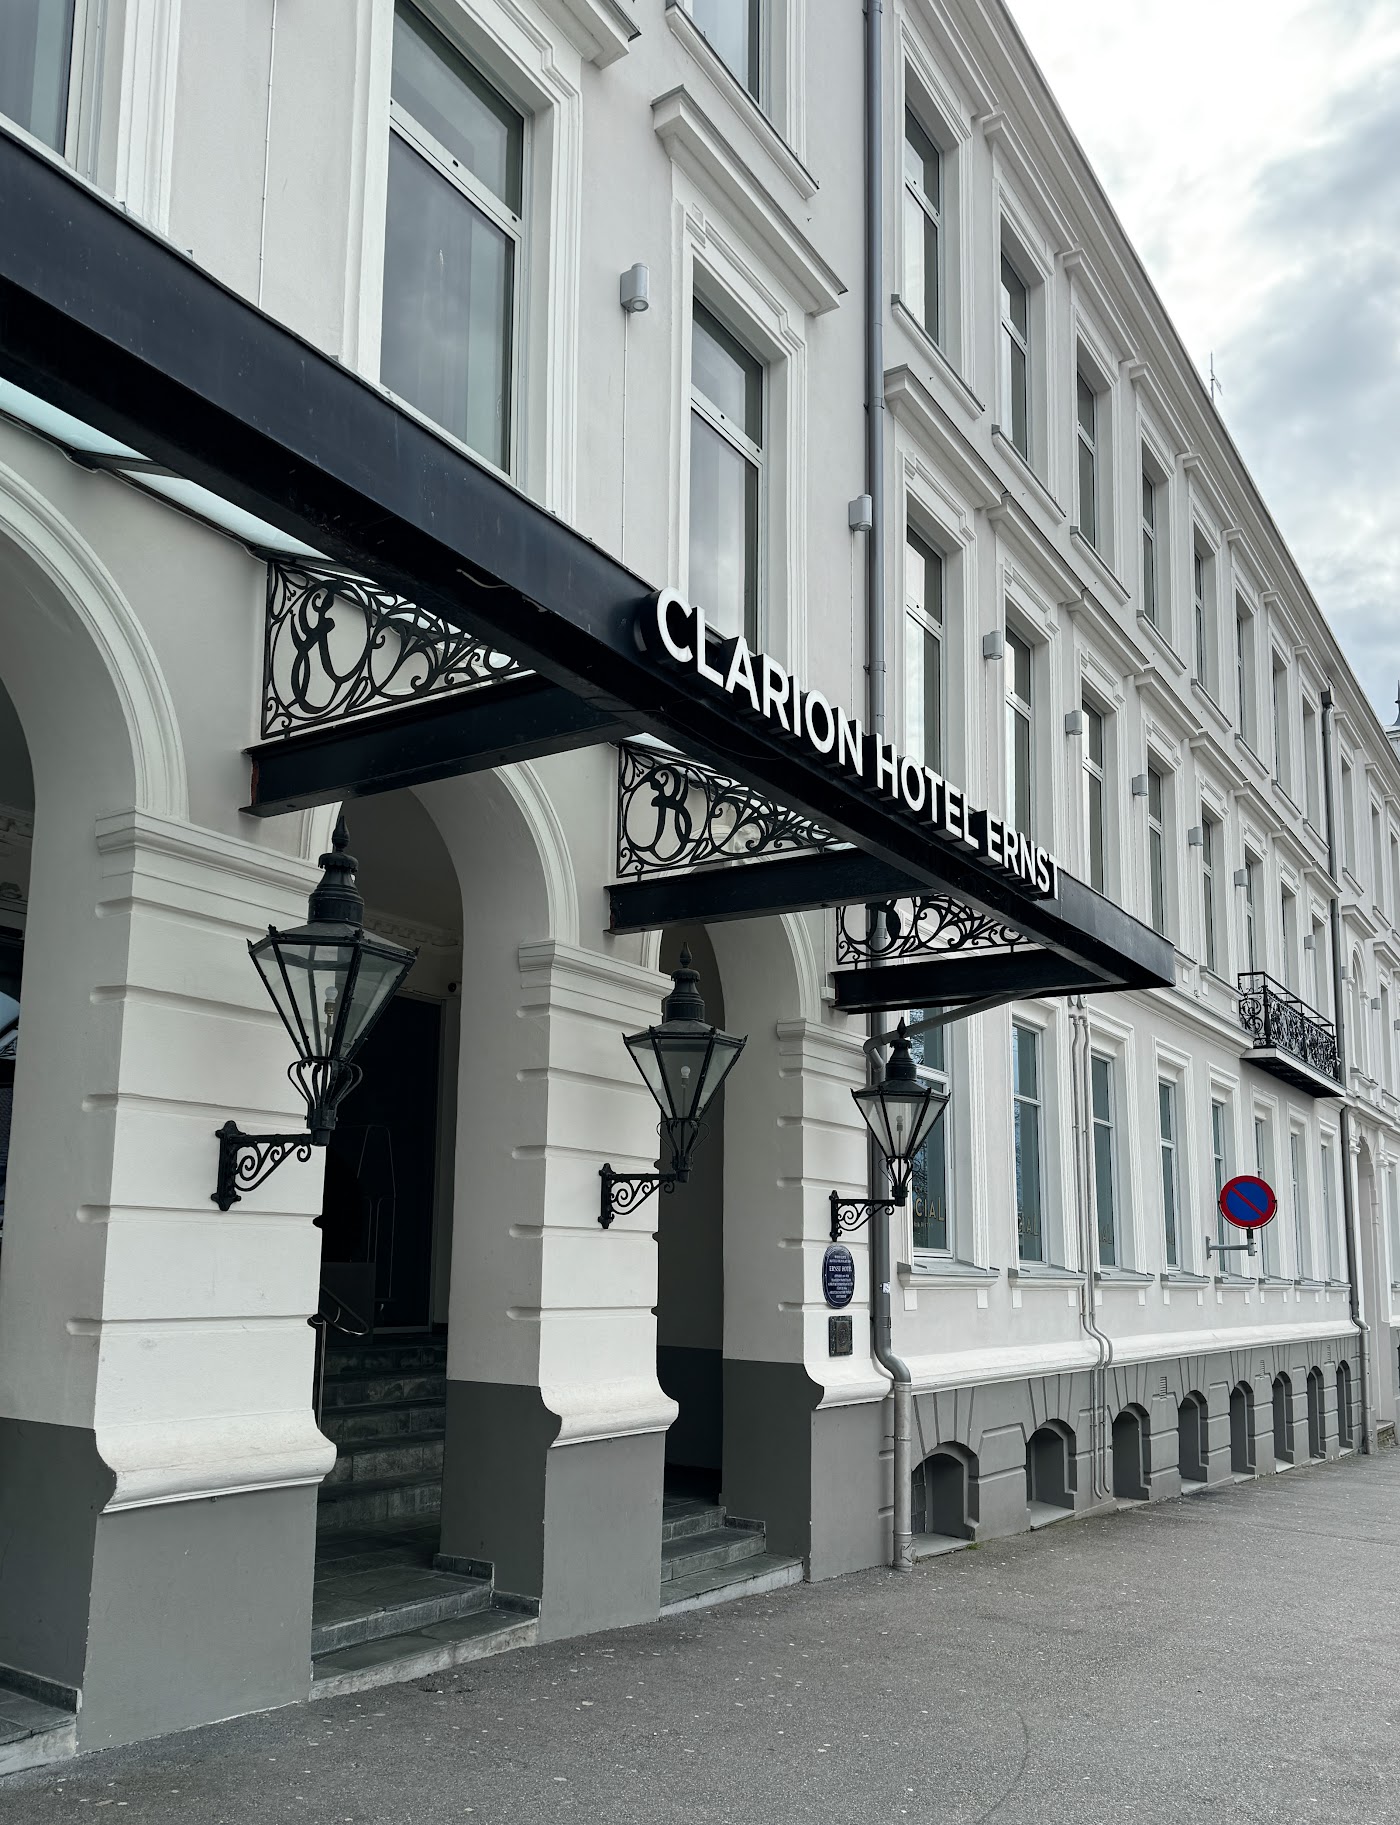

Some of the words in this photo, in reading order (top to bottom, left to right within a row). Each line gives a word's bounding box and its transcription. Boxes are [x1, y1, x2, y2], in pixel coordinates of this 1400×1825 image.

[657, 586, 864, 777] CLARION
[876, 733, 980, 850] HOTEL
[987, 810, 1062, 901] ERNST
